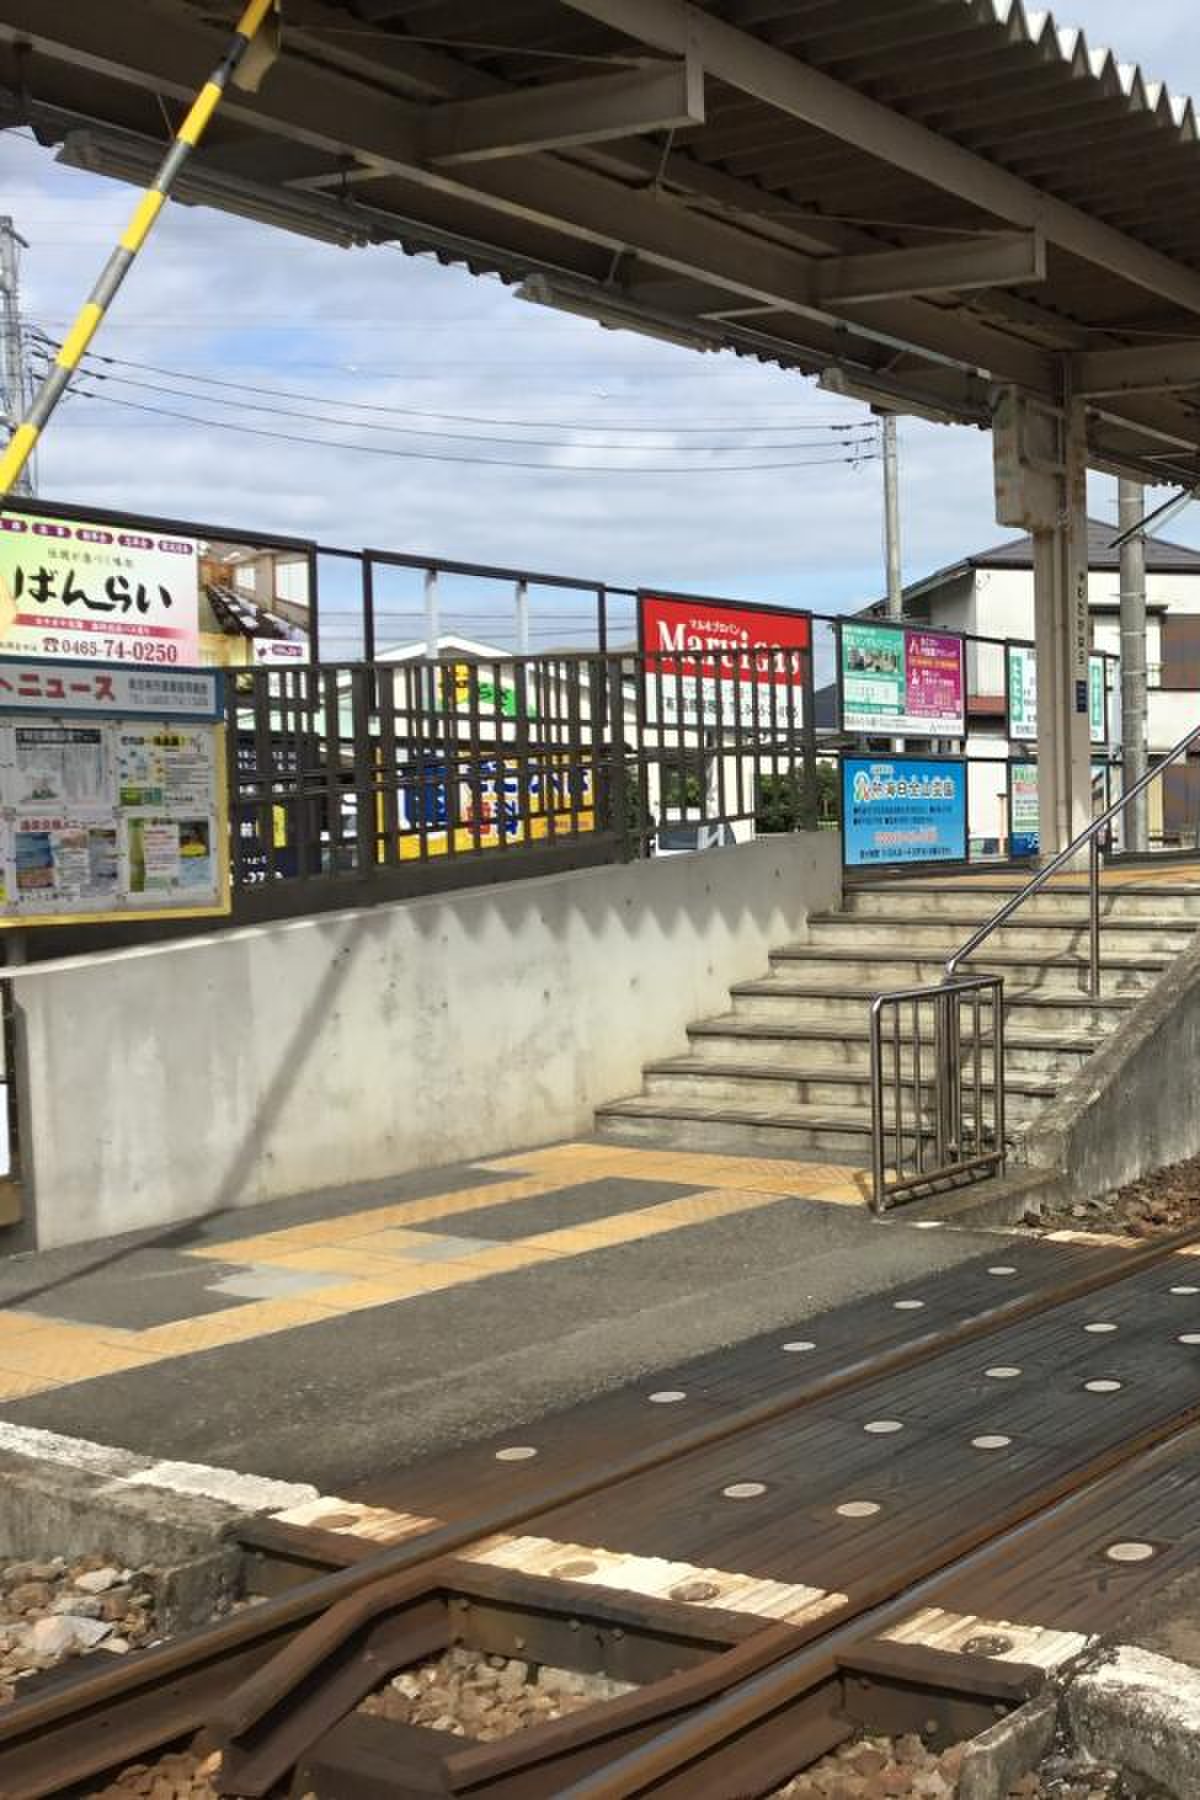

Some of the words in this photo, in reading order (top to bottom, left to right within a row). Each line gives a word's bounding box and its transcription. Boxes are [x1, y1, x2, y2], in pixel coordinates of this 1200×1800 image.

[14, 564, 173, 614] ばんらい
[62, 638, 178, 664] 0465-74-0250
